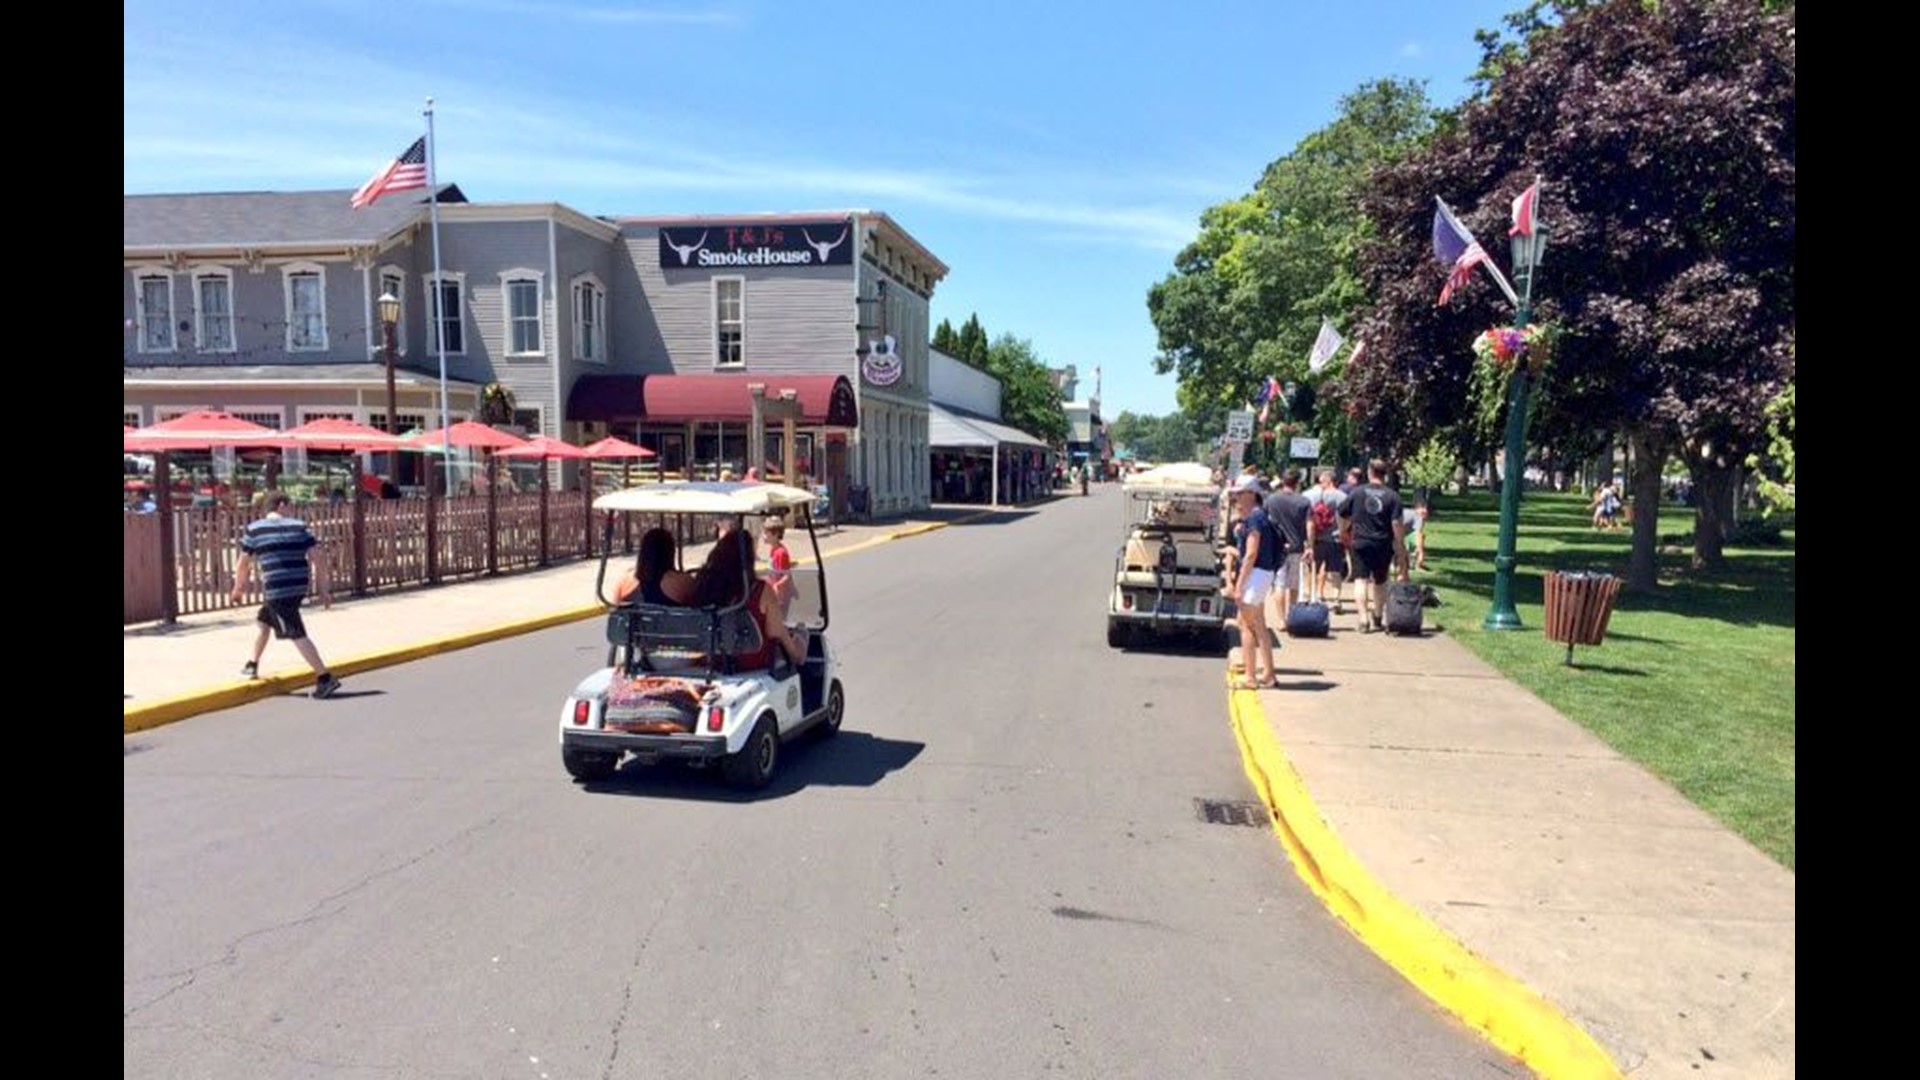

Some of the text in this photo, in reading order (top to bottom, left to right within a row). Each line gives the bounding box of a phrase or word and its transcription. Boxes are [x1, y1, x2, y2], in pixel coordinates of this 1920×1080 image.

[725, 226, 738, 249] T
[741, 225, 755, 244] &
[698, 247, 812, 265] SmokeHouse
[1229, 426, 1250, 440] 25
